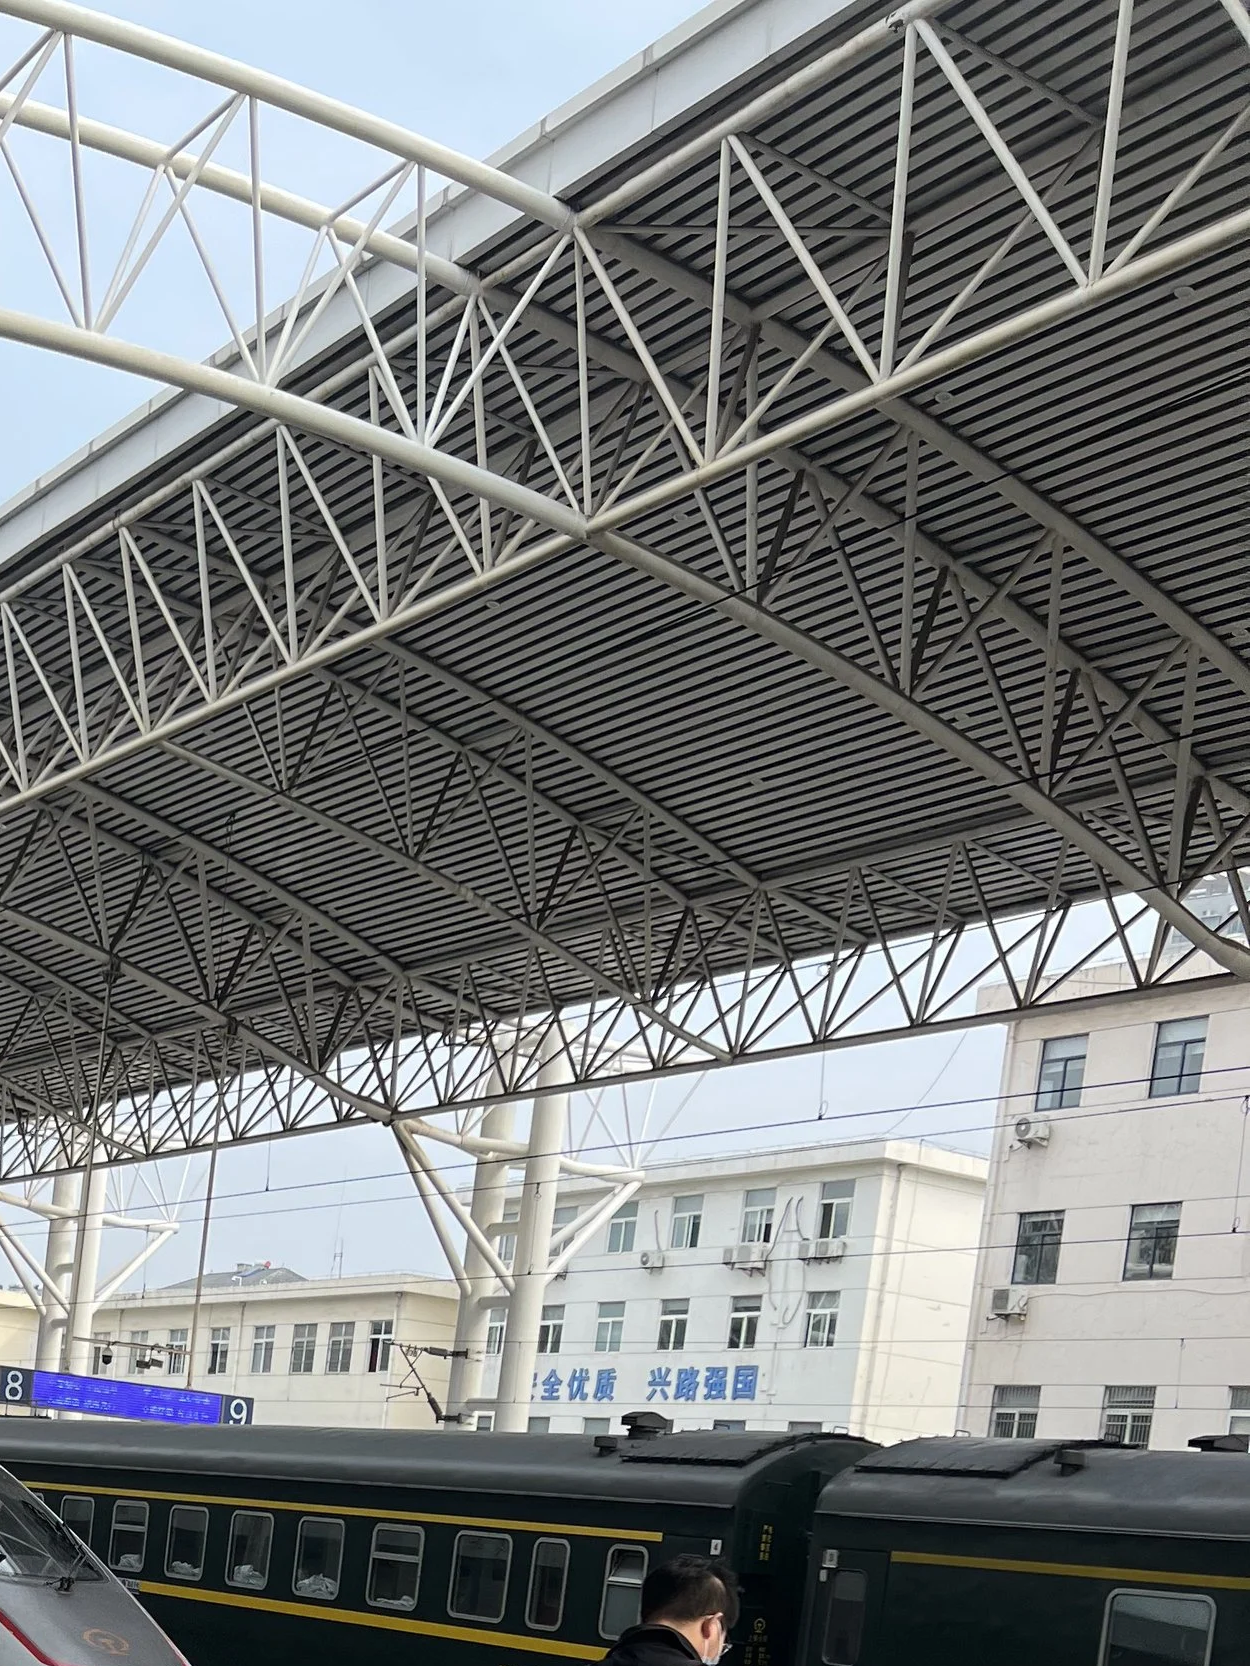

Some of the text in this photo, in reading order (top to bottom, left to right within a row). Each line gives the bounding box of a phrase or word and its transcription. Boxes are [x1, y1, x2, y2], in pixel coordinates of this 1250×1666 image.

[5, 1370, 23, 1401] 8
[646, 1365, 758, 1401] 兴路强国
[230, 1398, 247, 1425] 9
